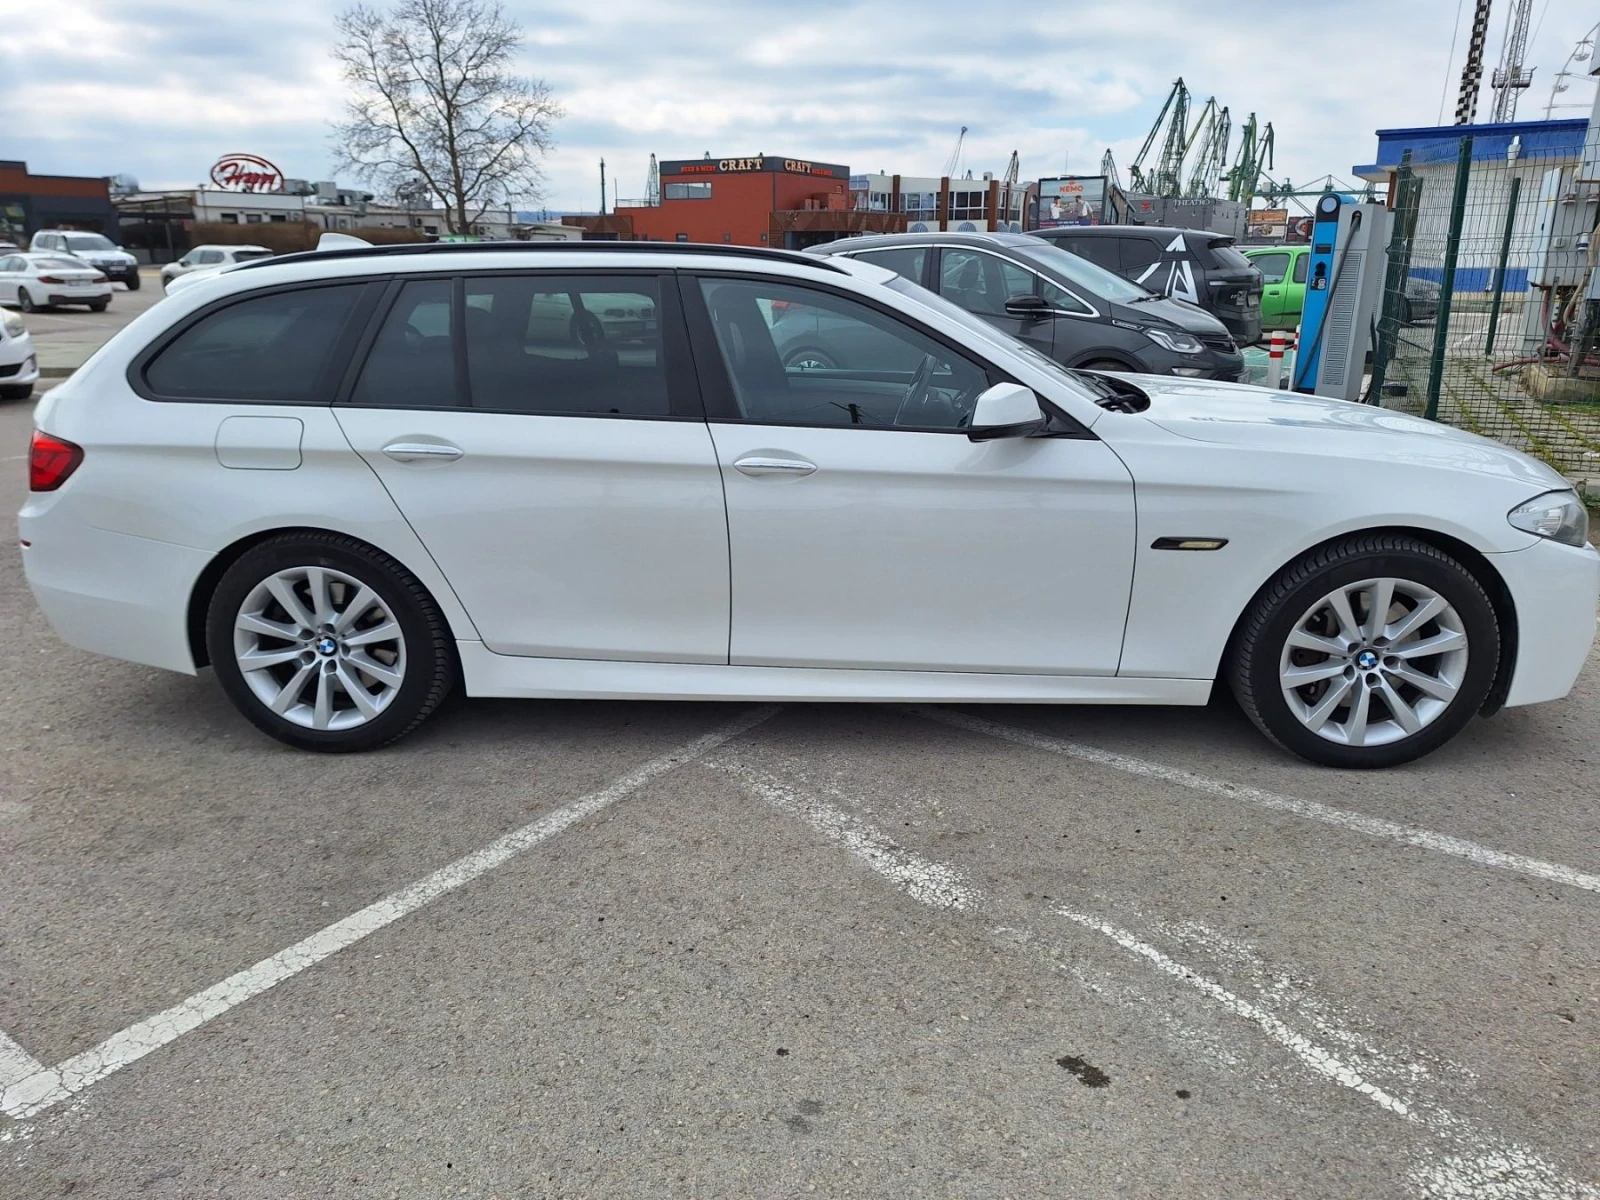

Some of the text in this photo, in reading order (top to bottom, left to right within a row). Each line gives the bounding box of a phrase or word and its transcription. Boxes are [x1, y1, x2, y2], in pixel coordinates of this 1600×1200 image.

[719, 158, 763, 171] CRAFT
[784, 159, 812, 174] CRAFT
[1059, 185, 1084, 193] NEMO
